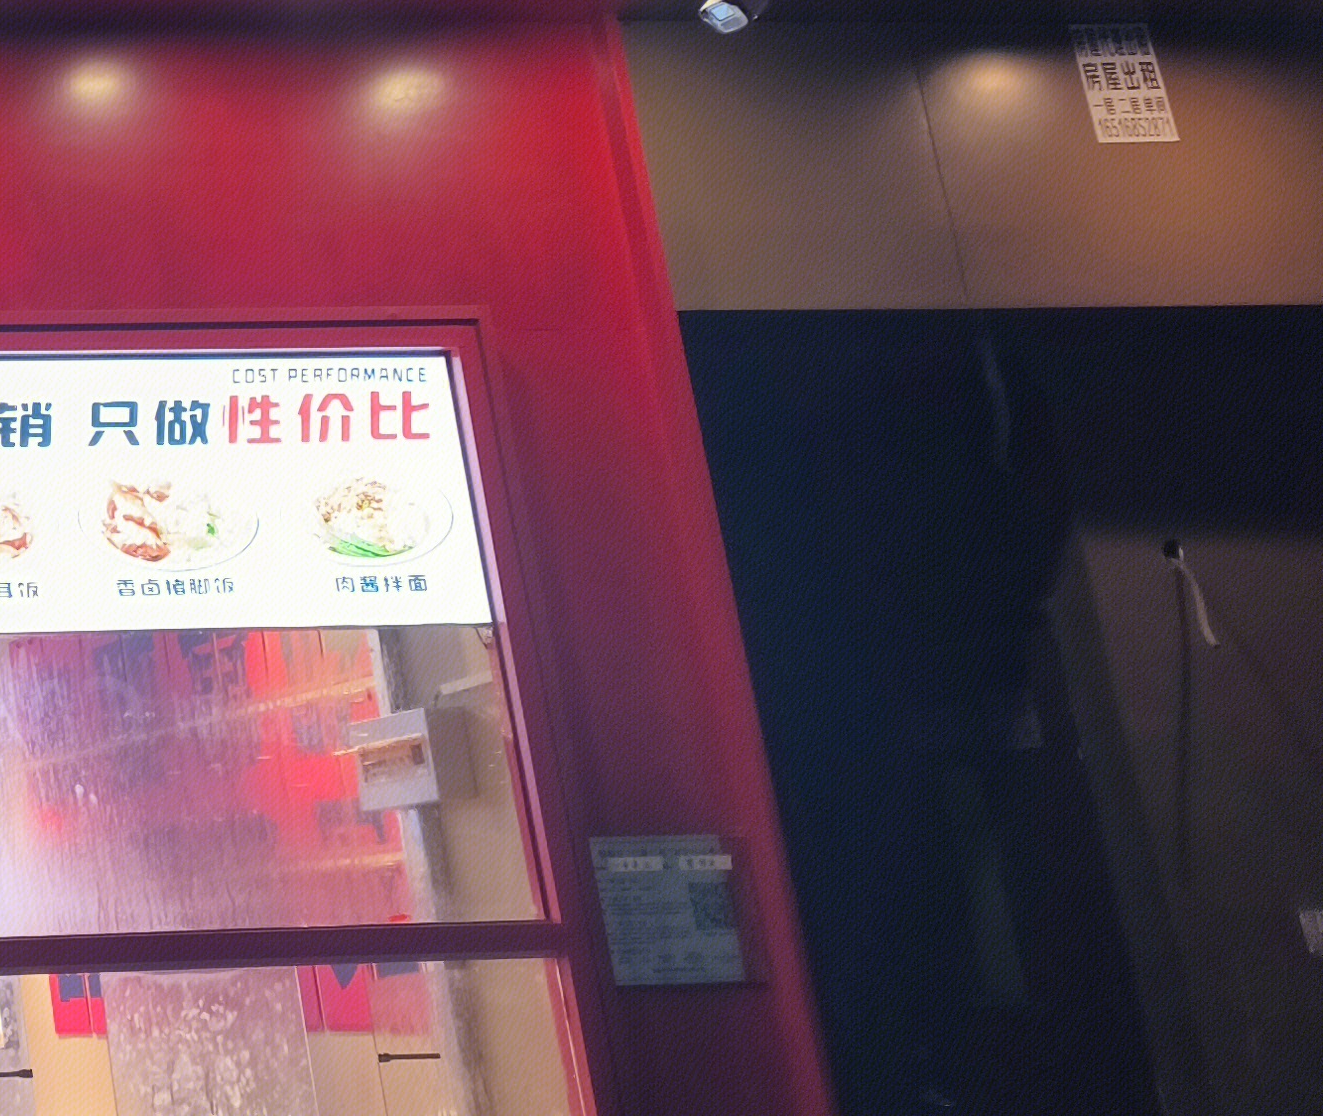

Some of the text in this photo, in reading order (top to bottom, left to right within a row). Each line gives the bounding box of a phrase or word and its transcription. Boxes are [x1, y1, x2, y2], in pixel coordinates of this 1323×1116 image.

[1081, 60, 1161, 91] 房屋出租
[232, 367, 428, 384] COST PERFORMANCE
[87, 391, 432, 447] 只做性价比
[335, 574, 428, 593] 肉酱拌面
